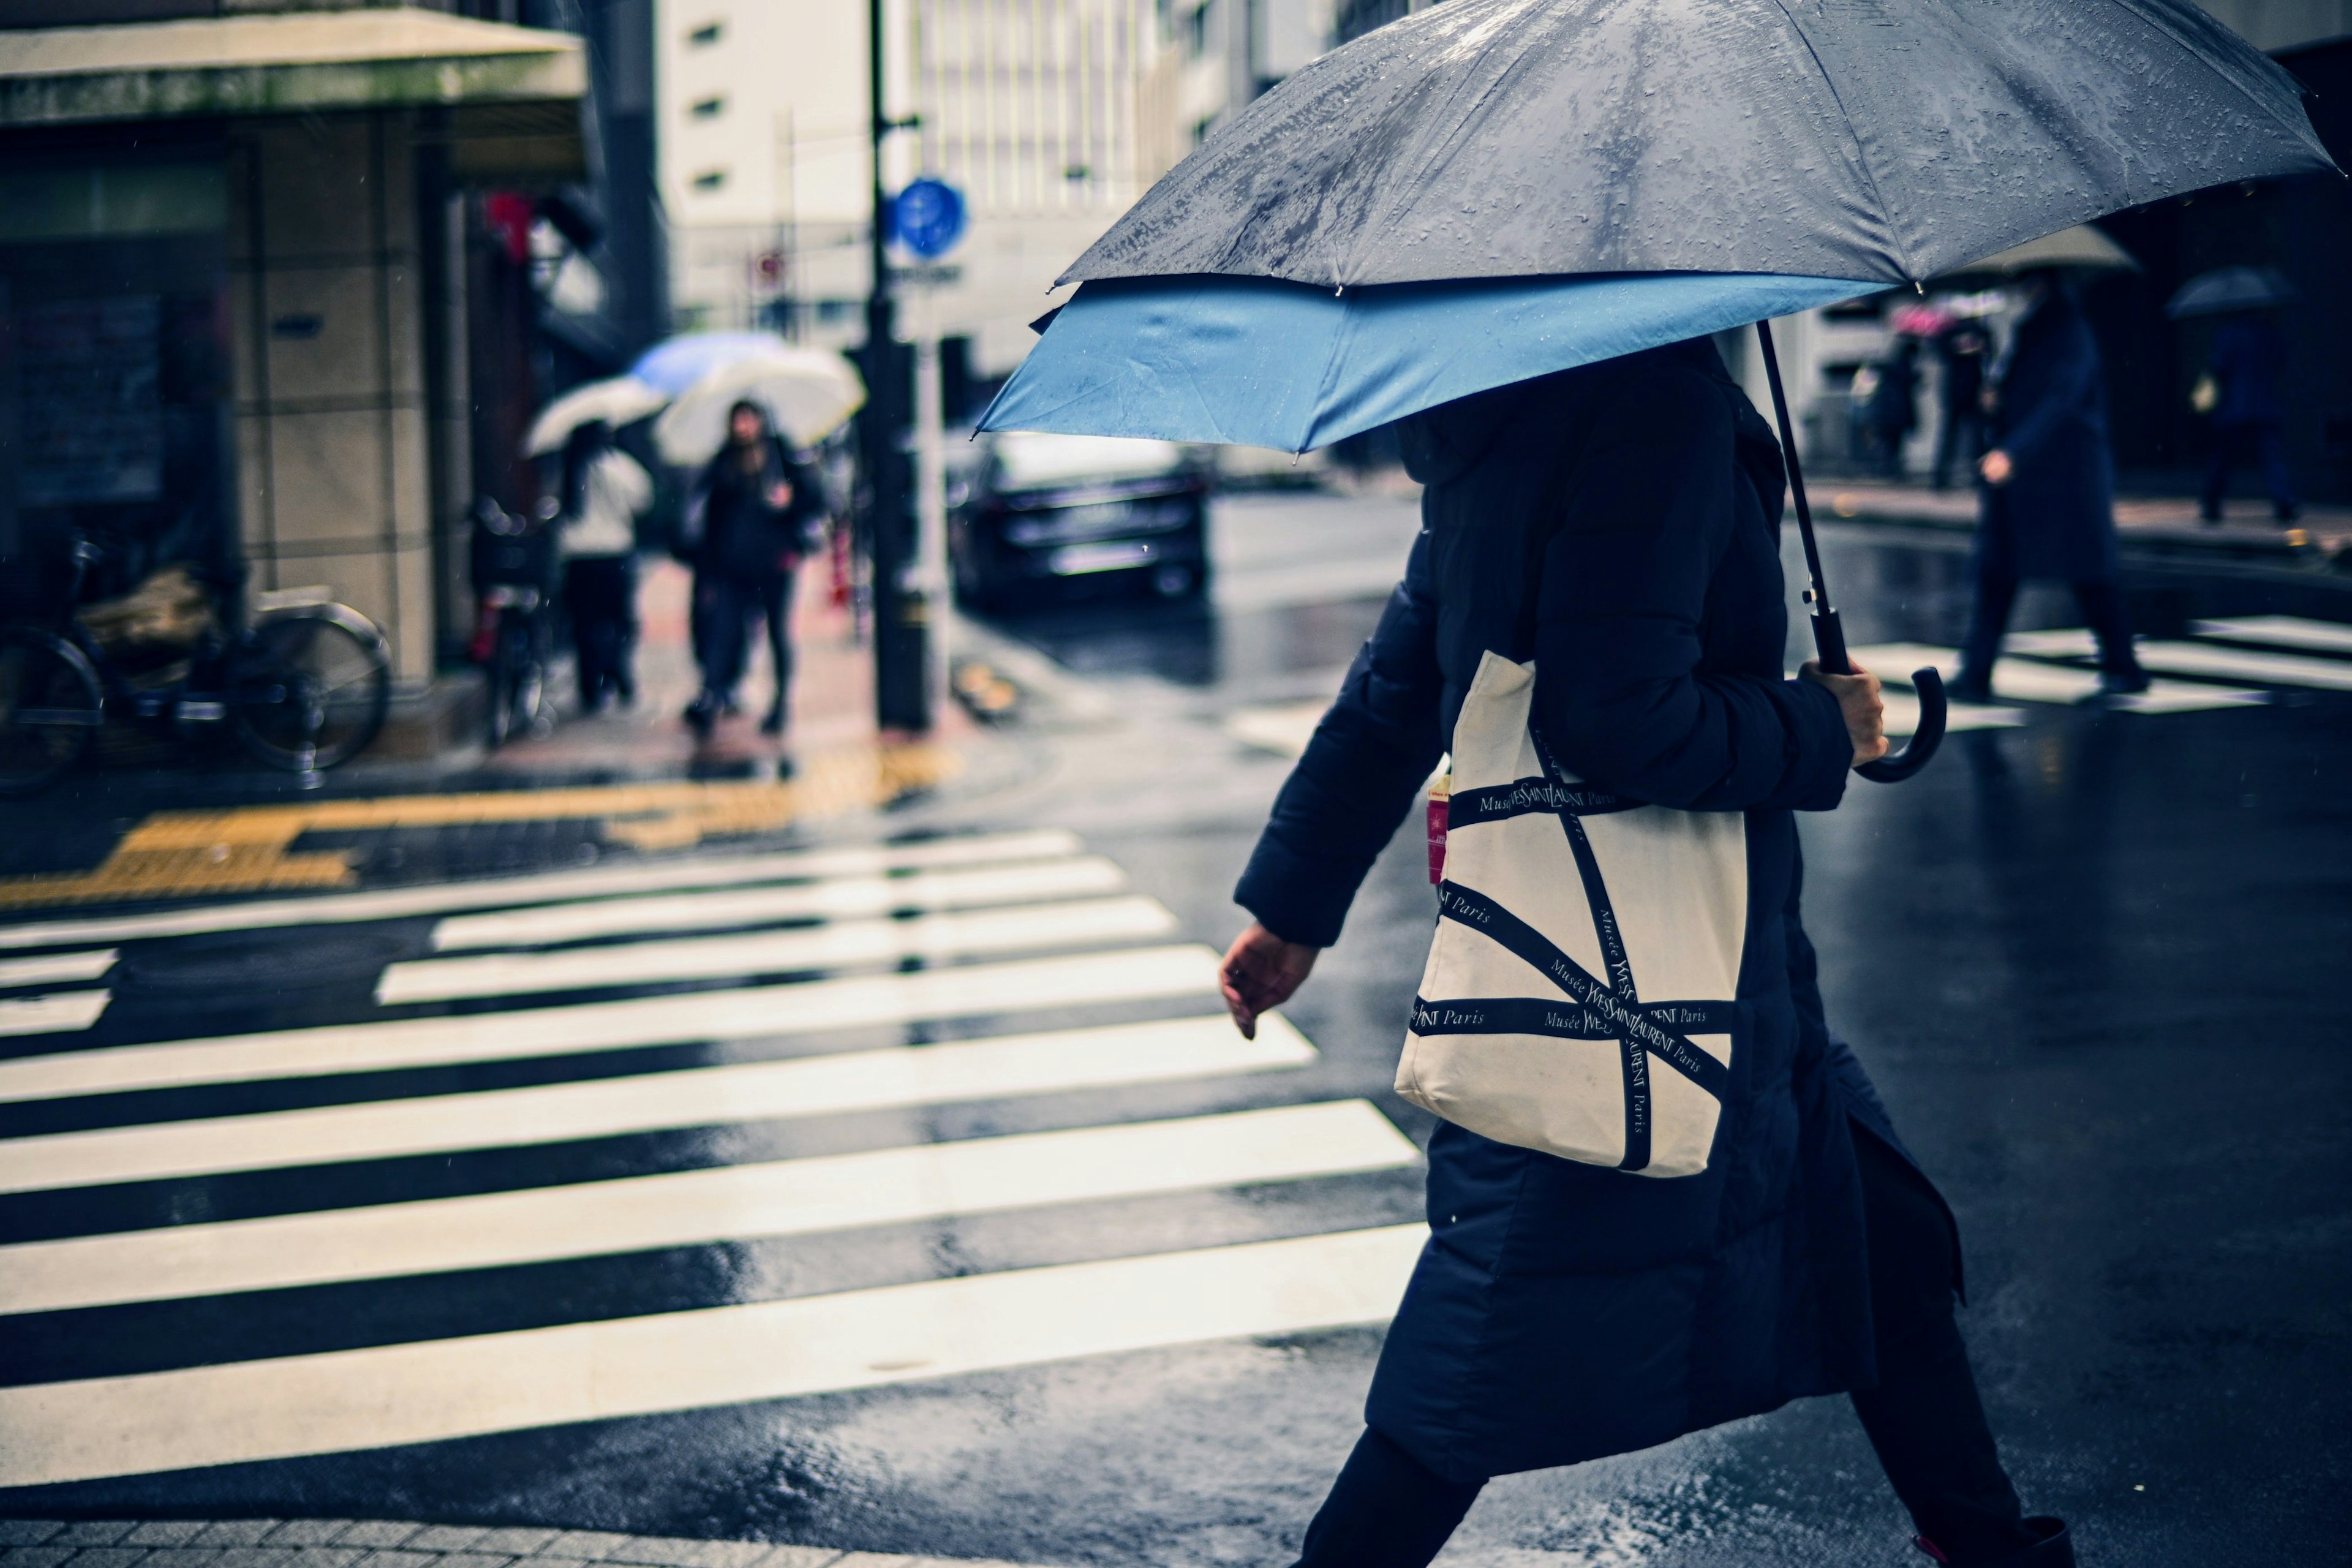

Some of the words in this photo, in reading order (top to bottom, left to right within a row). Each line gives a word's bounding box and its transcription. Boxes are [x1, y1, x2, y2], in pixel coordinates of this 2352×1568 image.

[1452, 897, 1490, 923] Paris
[1443, 1009, 1484, 1025] Paris
[1545, 1012, 1580, 1029] Musée
[1680, 1008, 1706, 1023] Paris
[1551, 959, 1585, 993] Musée
[1673, 1046, 1701, 1072] Paris
[1600, 910, 1619, 956] Musée
[1634, 1095, 1645, 1133] Paris
